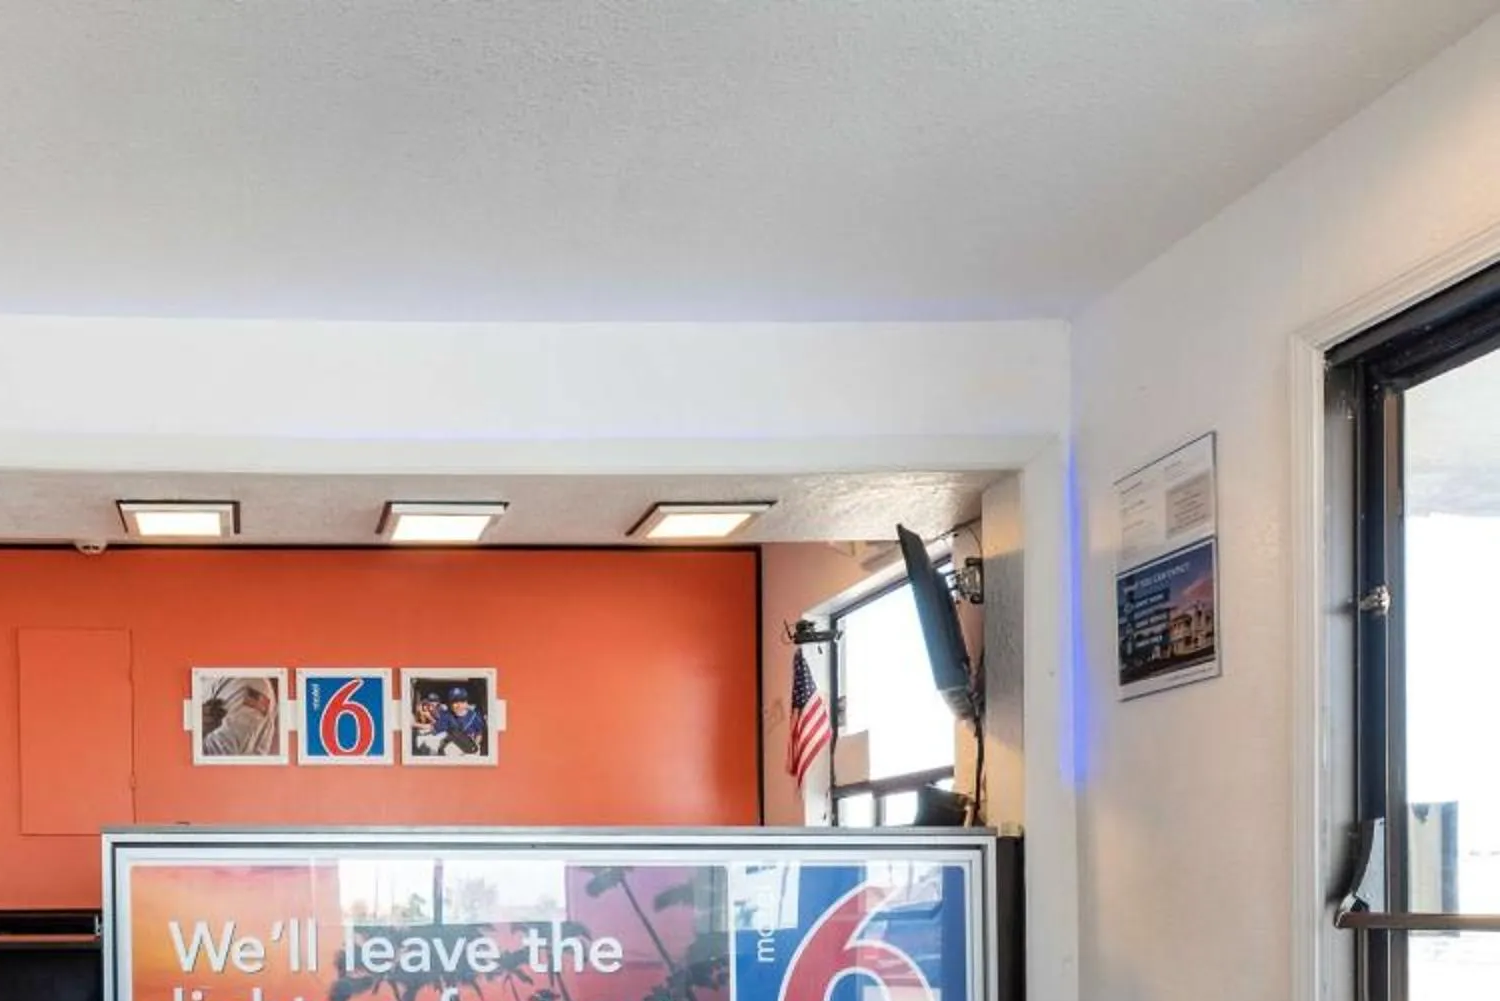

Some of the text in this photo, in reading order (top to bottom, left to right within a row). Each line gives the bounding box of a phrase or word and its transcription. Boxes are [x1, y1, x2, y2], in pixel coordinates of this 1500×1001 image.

[319, 677, 375, 757] 6
[345, 917, 500, 973] leave
[522, 917, 623, 973] the
